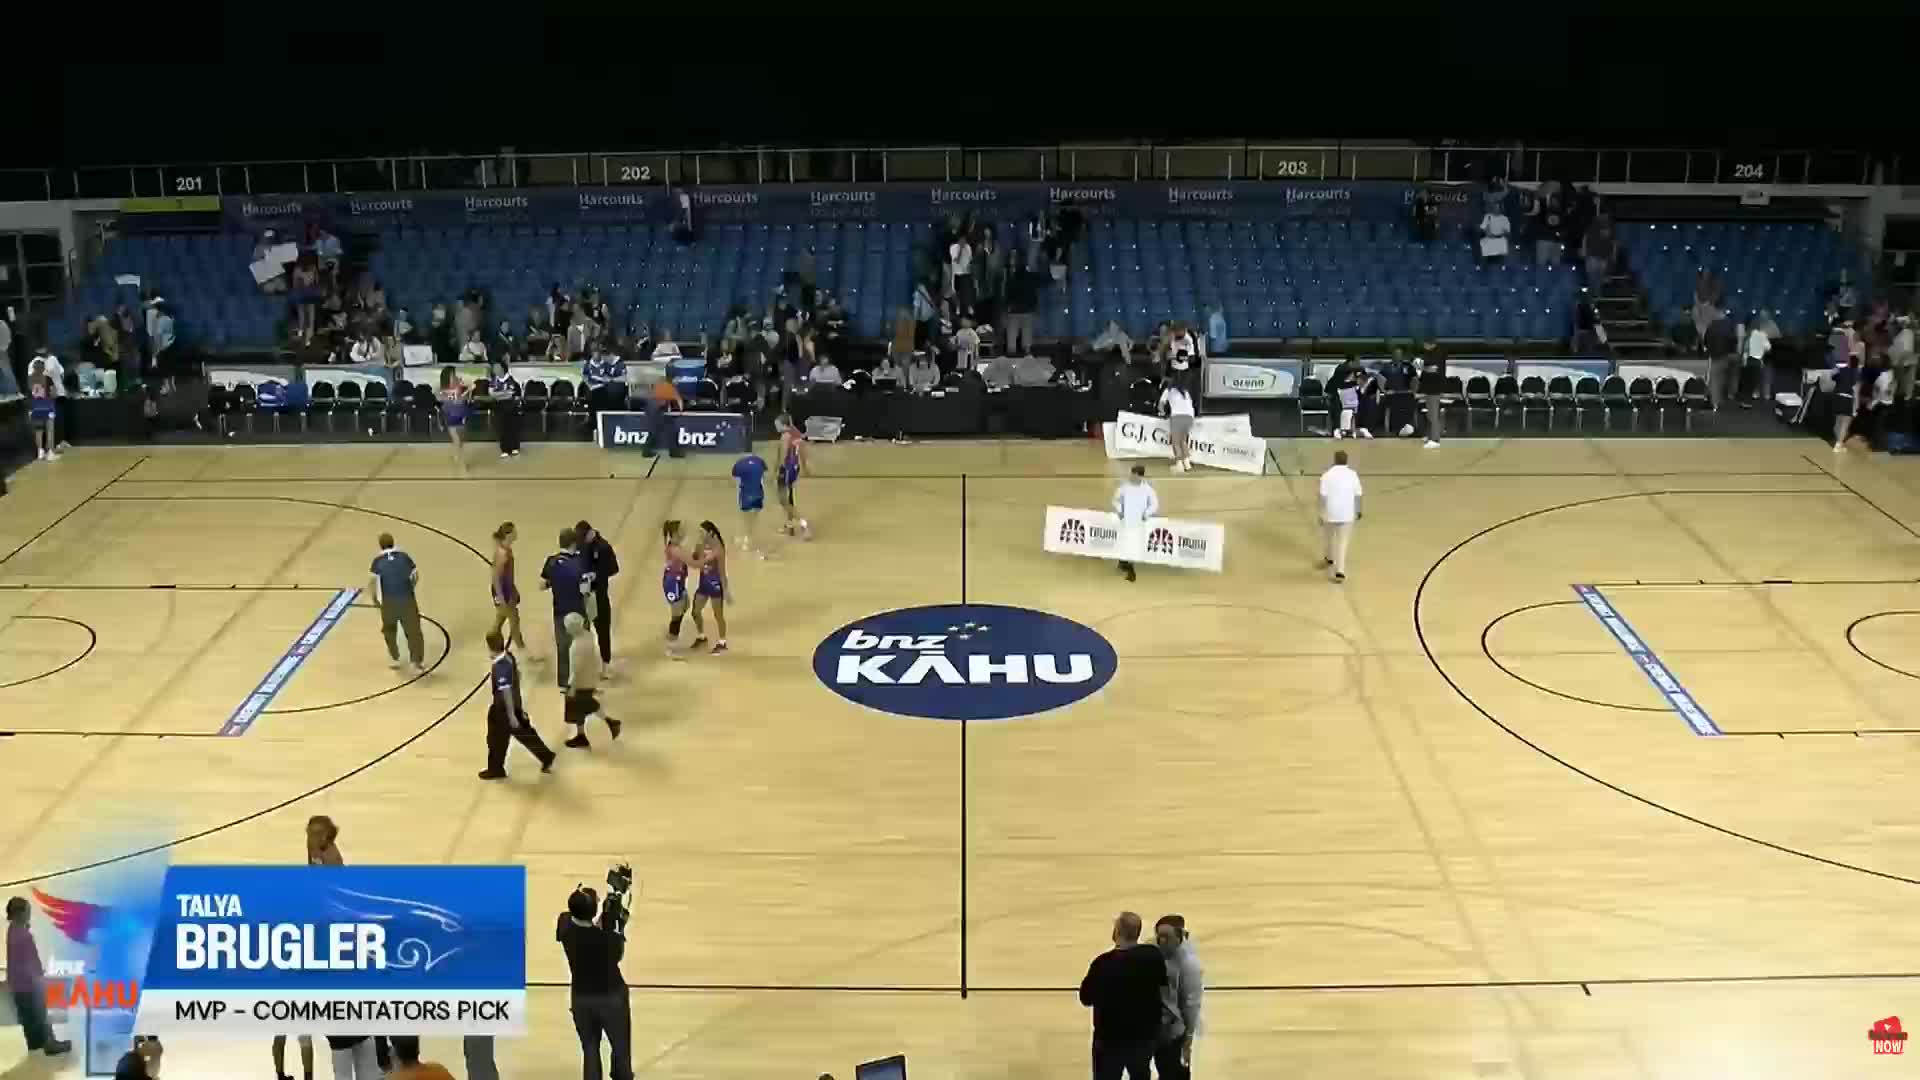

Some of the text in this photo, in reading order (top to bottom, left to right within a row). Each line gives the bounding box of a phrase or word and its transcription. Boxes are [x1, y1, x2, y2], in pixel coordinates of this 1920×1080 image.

[621, 166, 650, 181] 202
[1278, 160, 1308, 176] 203
[1734, 163, 1764, 179] 204
[176, 176, 202, 191] 201
[579, 193, 643, 207] Harcourts
[693, 191, 759, 204] Harcourts
[810, 191, 876, 204] Harcourts
[931, 187, 997, 202] Harcourts
[1050, 187, 1116, 201] Harcourts
[1168, 187, 1233, 202] Harcourts
[1286, 187, 1351, 202] Harcourts
[351, 199, 414, 213] Harcourts
[465, 195, 528, 209] Harcourts
[678, 427, 717, 445] bnz
[841, 629, 949, 649] bnz
[836, 650, 1095, 684] KĀHU
